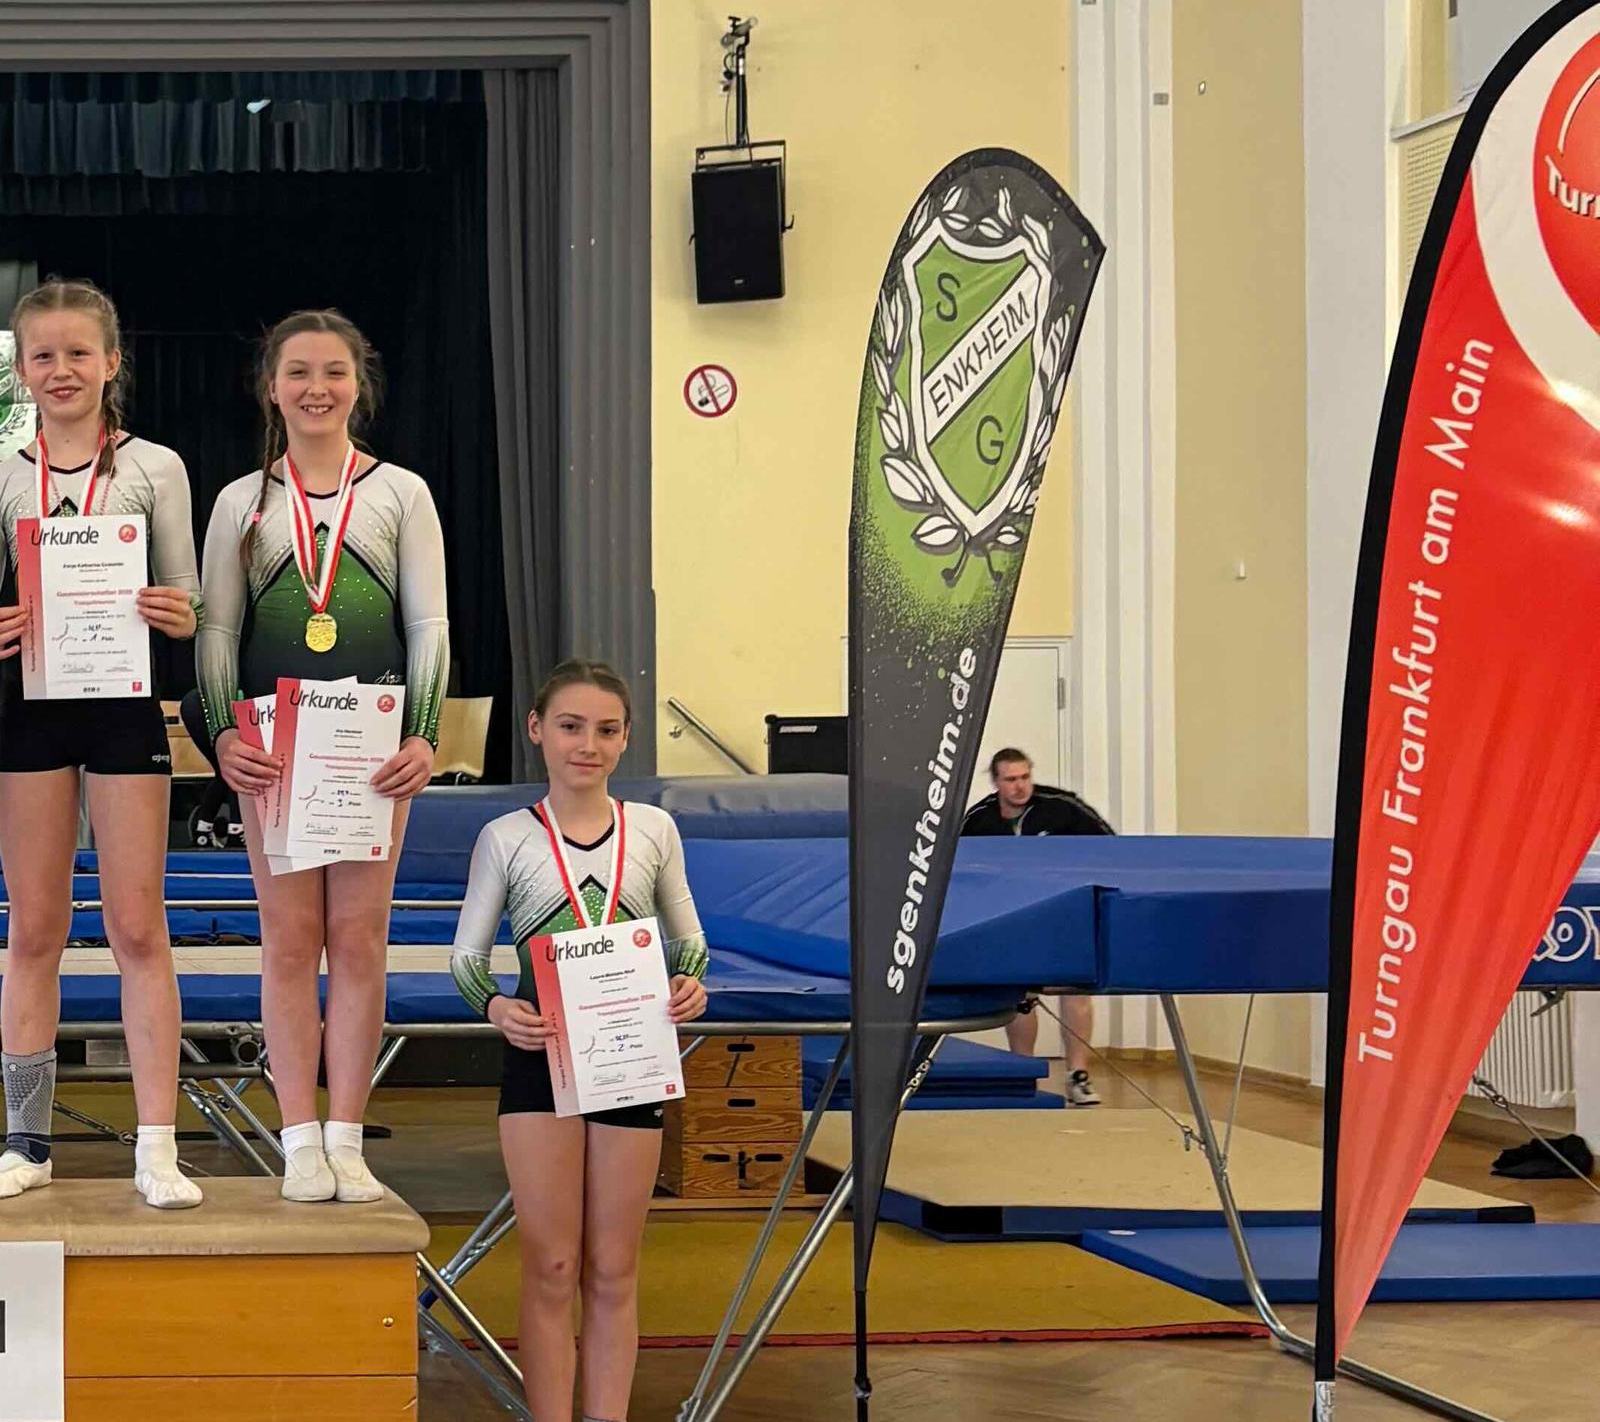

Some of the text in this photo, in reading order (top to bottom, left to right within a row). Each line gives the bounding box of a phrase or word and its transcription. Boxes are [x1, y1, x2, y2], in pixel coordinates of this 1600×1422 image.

[936, 272, 961, 322] S
[928, 291, 1031, 418] ENKHEIM
[976, 415, 1005, 465] G
[31, 525, 99, 547] Urkunde
[289, 688, 359, 712] Urkunde
[1357, 338, 1495, 1063] Turngau Frankfurt am Main
[886, 646, 978, 995] sgenkheim.de
[546, 935, 615, 962] Urkunde
